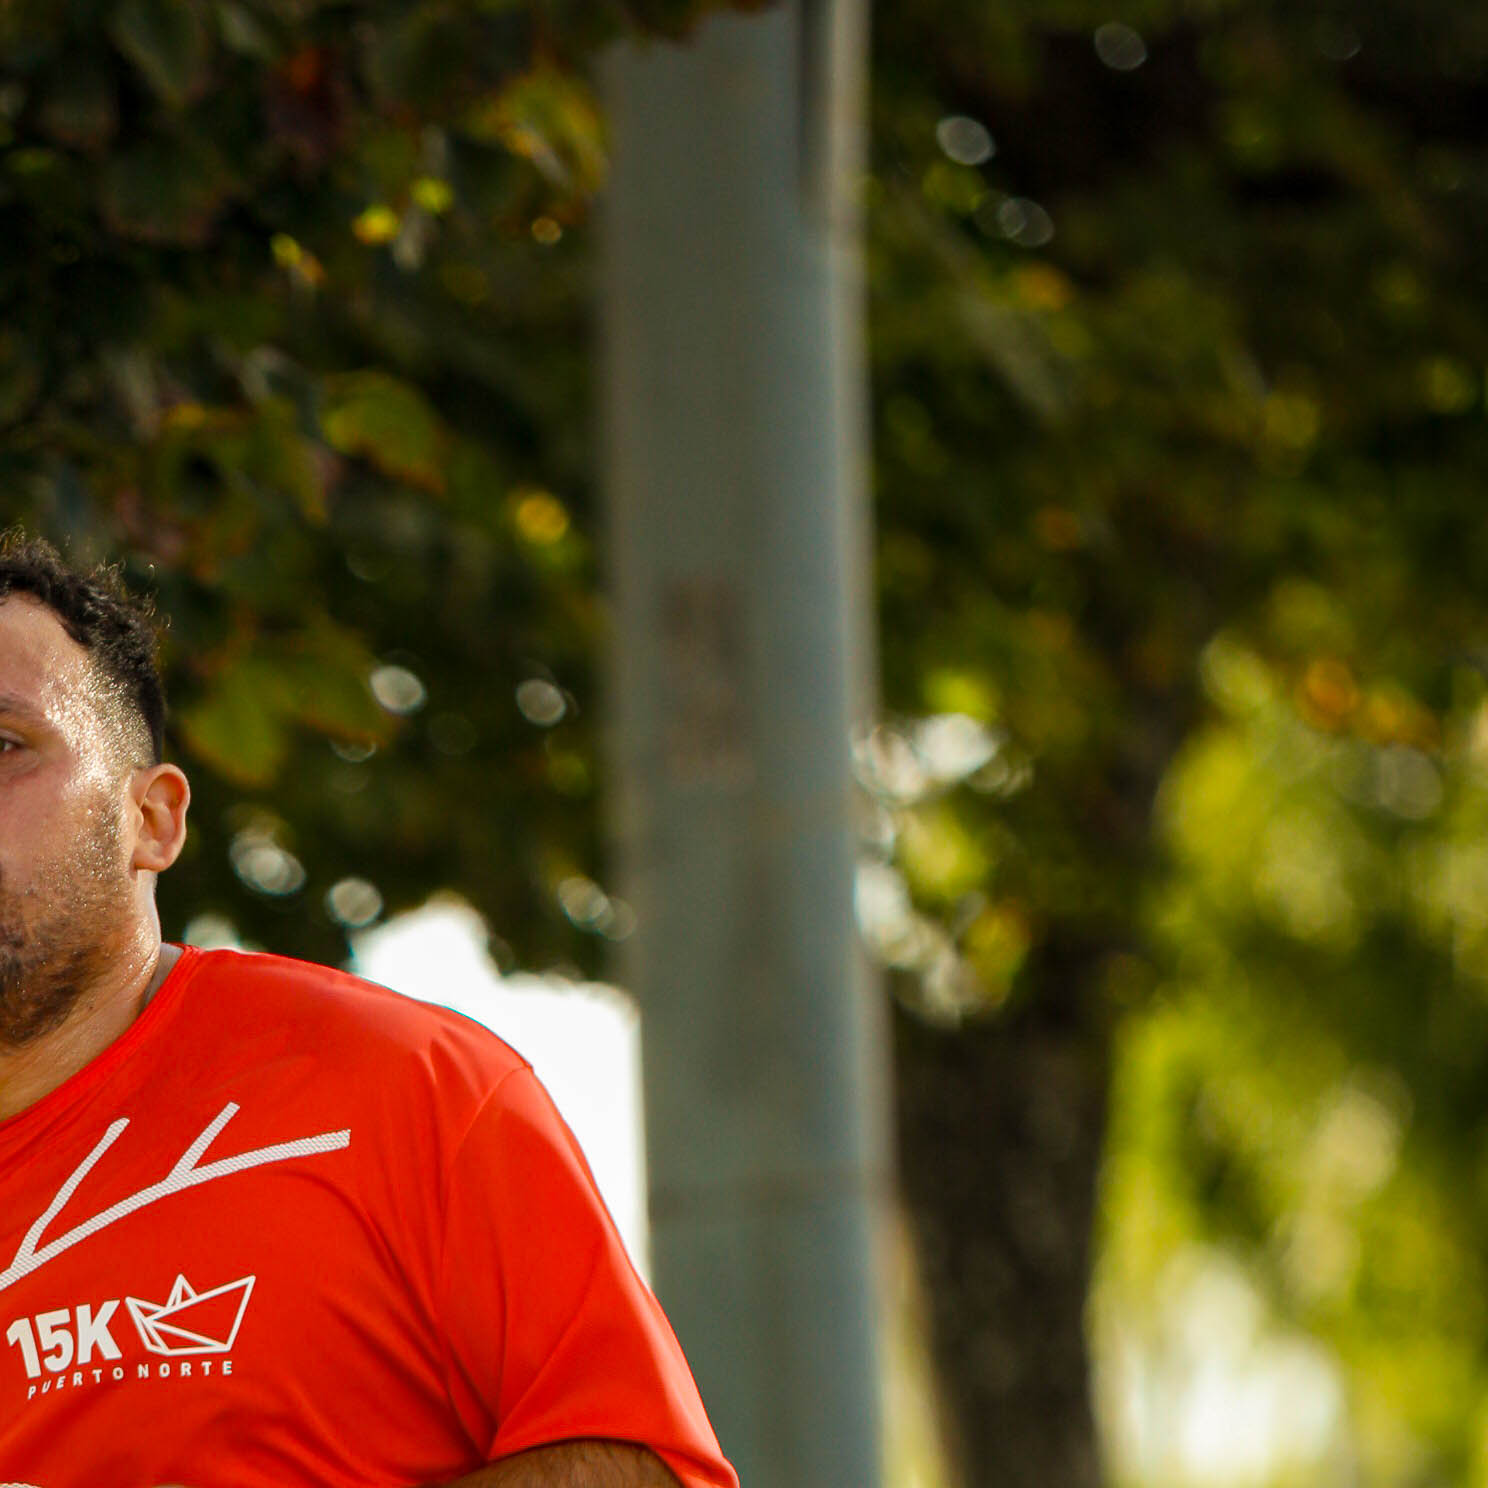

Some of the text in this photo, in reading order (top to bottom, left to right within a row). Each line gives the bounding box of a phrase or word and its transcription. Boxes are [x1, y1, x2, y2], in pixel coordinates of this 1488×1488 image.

[6, 1299, 123, 1379] 15K
[27, 1360, 233, 1400] PUERTO NORTE
